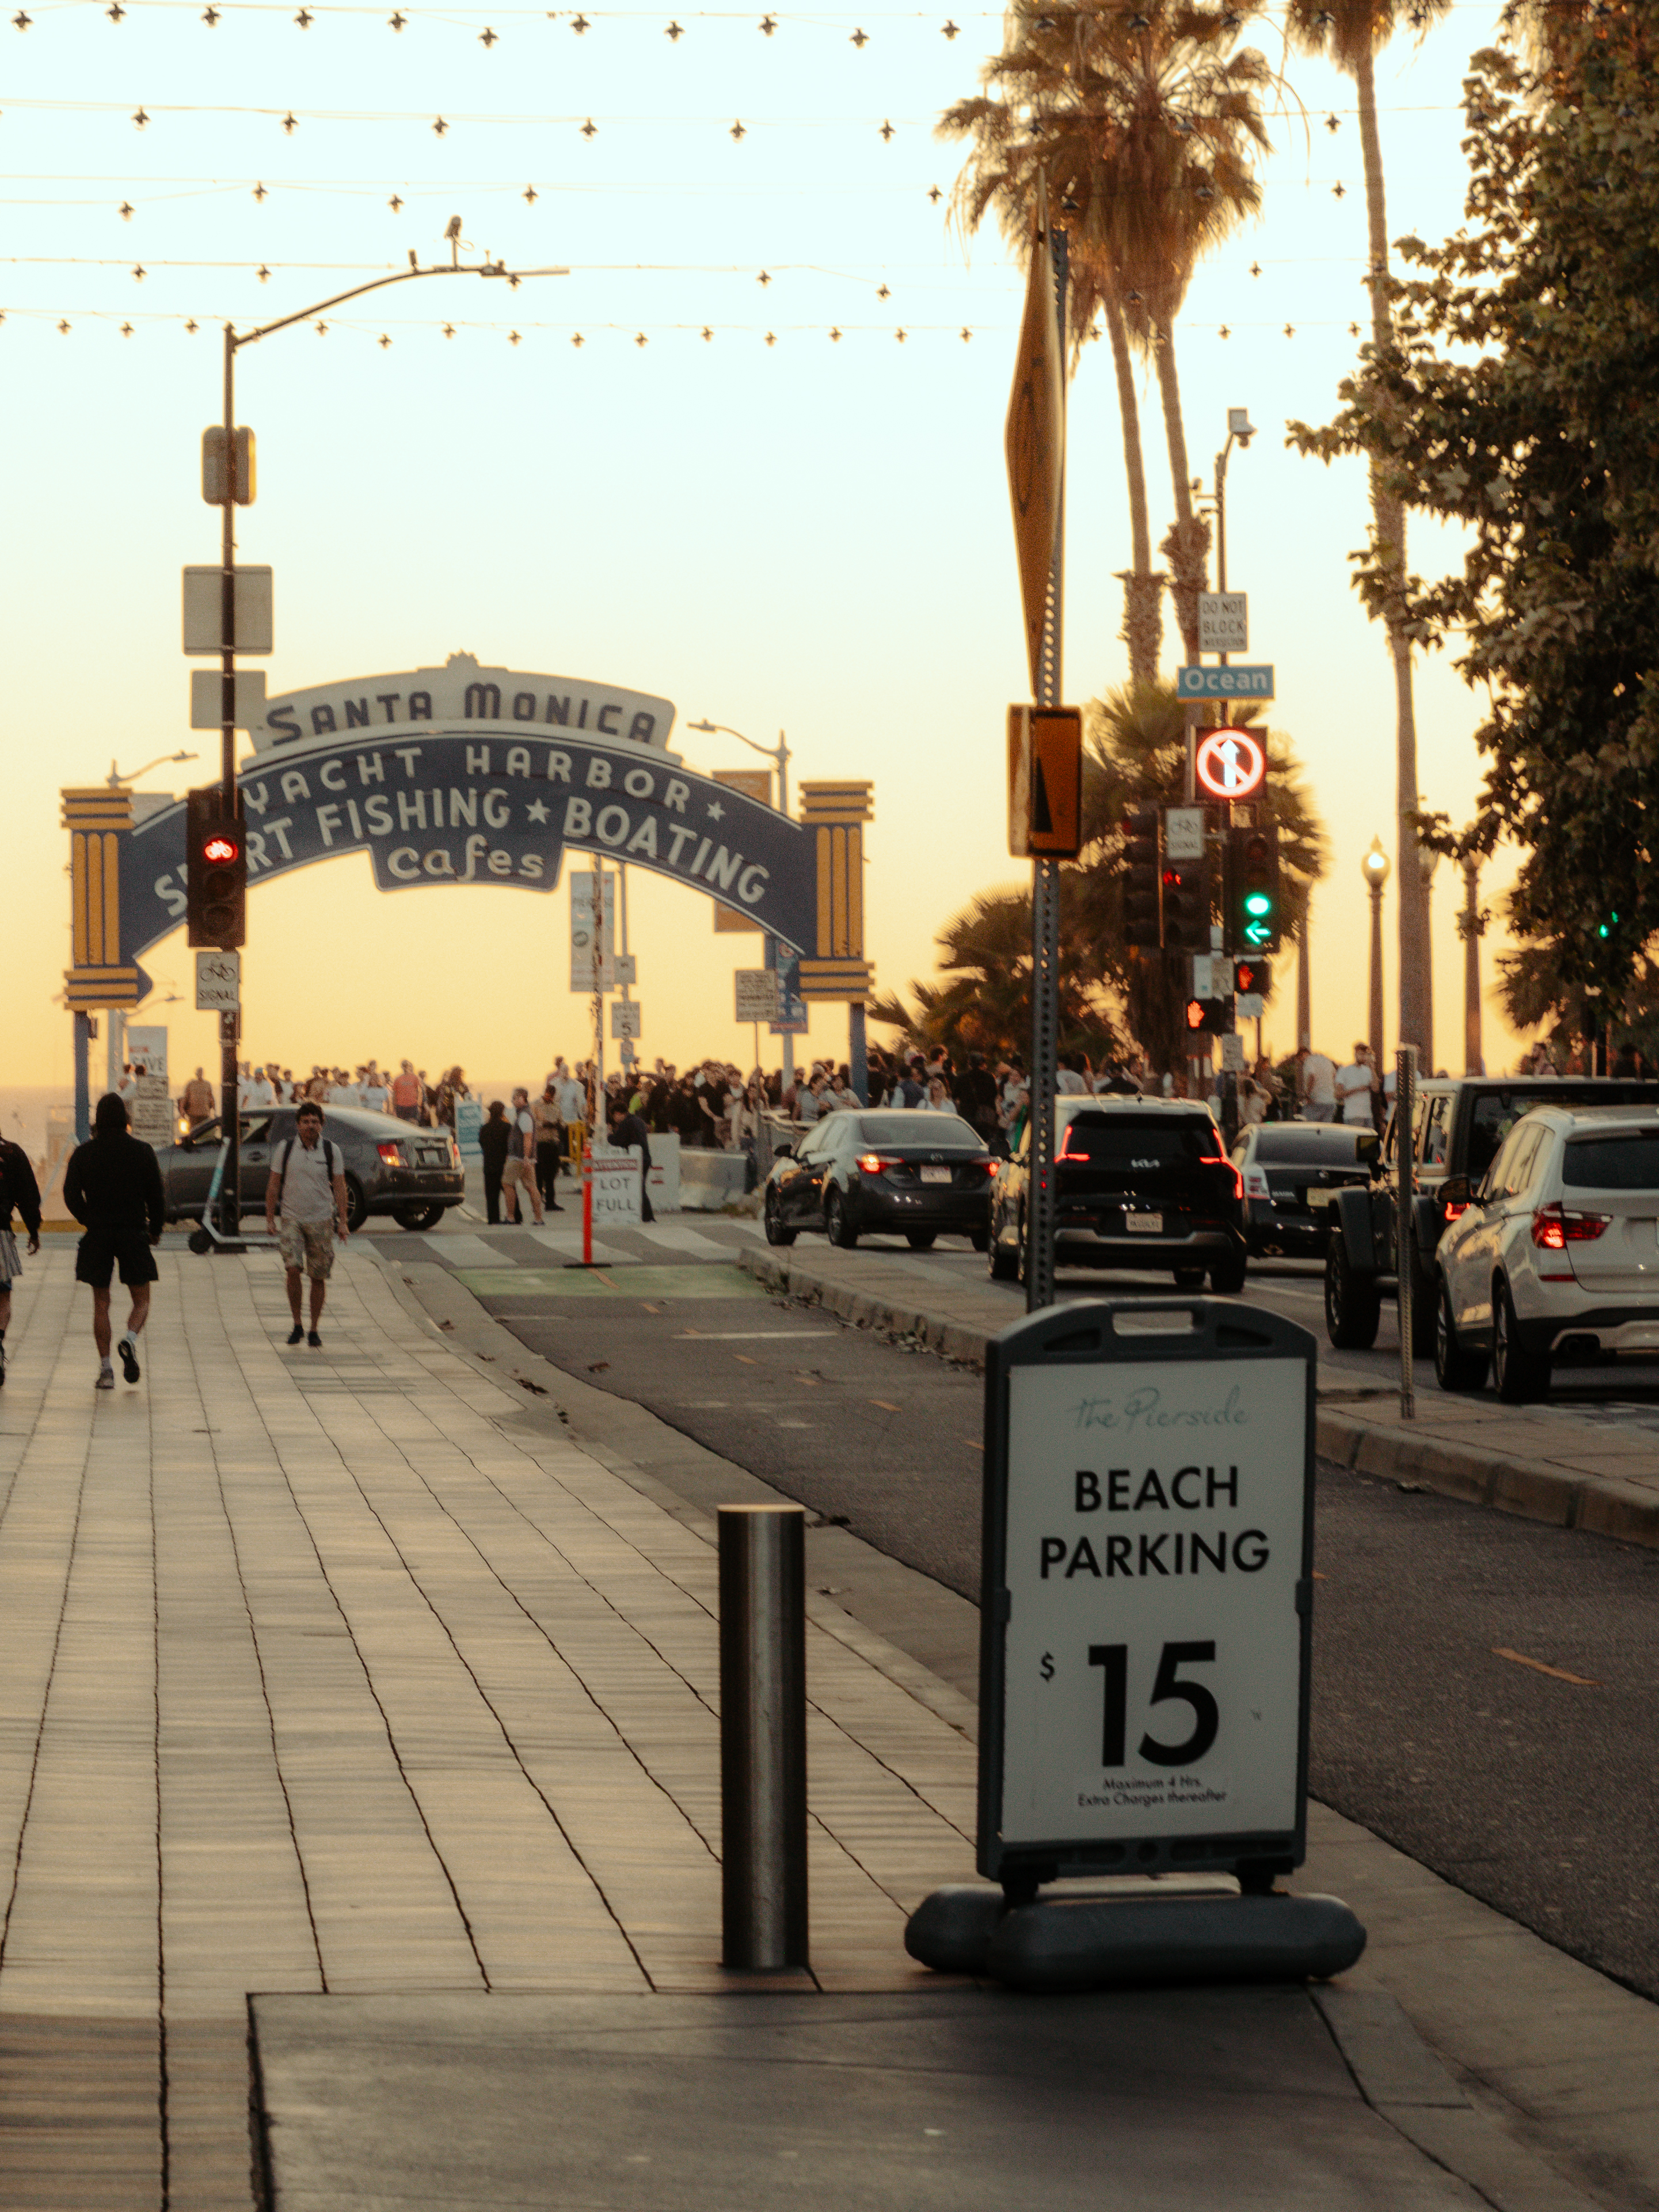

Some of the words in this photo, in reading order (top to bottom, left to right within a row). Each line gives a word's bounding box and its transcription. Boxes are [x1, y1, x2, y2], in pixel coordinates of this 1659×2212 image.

[1203, 600, 1218, 614] DO
[1222, 600, 1243, 614] NOT
[1203, 620, 1245, 634] BLOCK
[1185, 668, 1268, 691] Ocean
[265, 691, 432, 745] SANTA
[464, 682, 656, 744] MONICA
[244, 748, 423, 812] YACHT
[466, 744, 691, 814] HARBOR
[154, 817, 295, 917] SRT
[316, 788, 511, 846] FISHING
[563, 796, 771, 904] BOATING
[199, 989, 235, 1002] SIGNAL
[600, 1177, 630, 1191] LOT
[596, 1198, 635, 1212] FULL
[1124, 1384, 1250, 1434] Pierside
[1075, 1465, 1238, 1512] BEACH
[1040, 1529, 1270, 1579] PARKING
[1040, 1651, 1055, 1682] $
[1088, 1640, 1219, 1767] 15
[1103, 1777, 1164, 1791] Maximum
[1169, 1776, 1175, 1787] 4
[1078, 1792, 1110, 1806] Extra
[1113, 1791, 1164, 1807] Charges
[1167, 1787, 1227, 1803] thereafter
